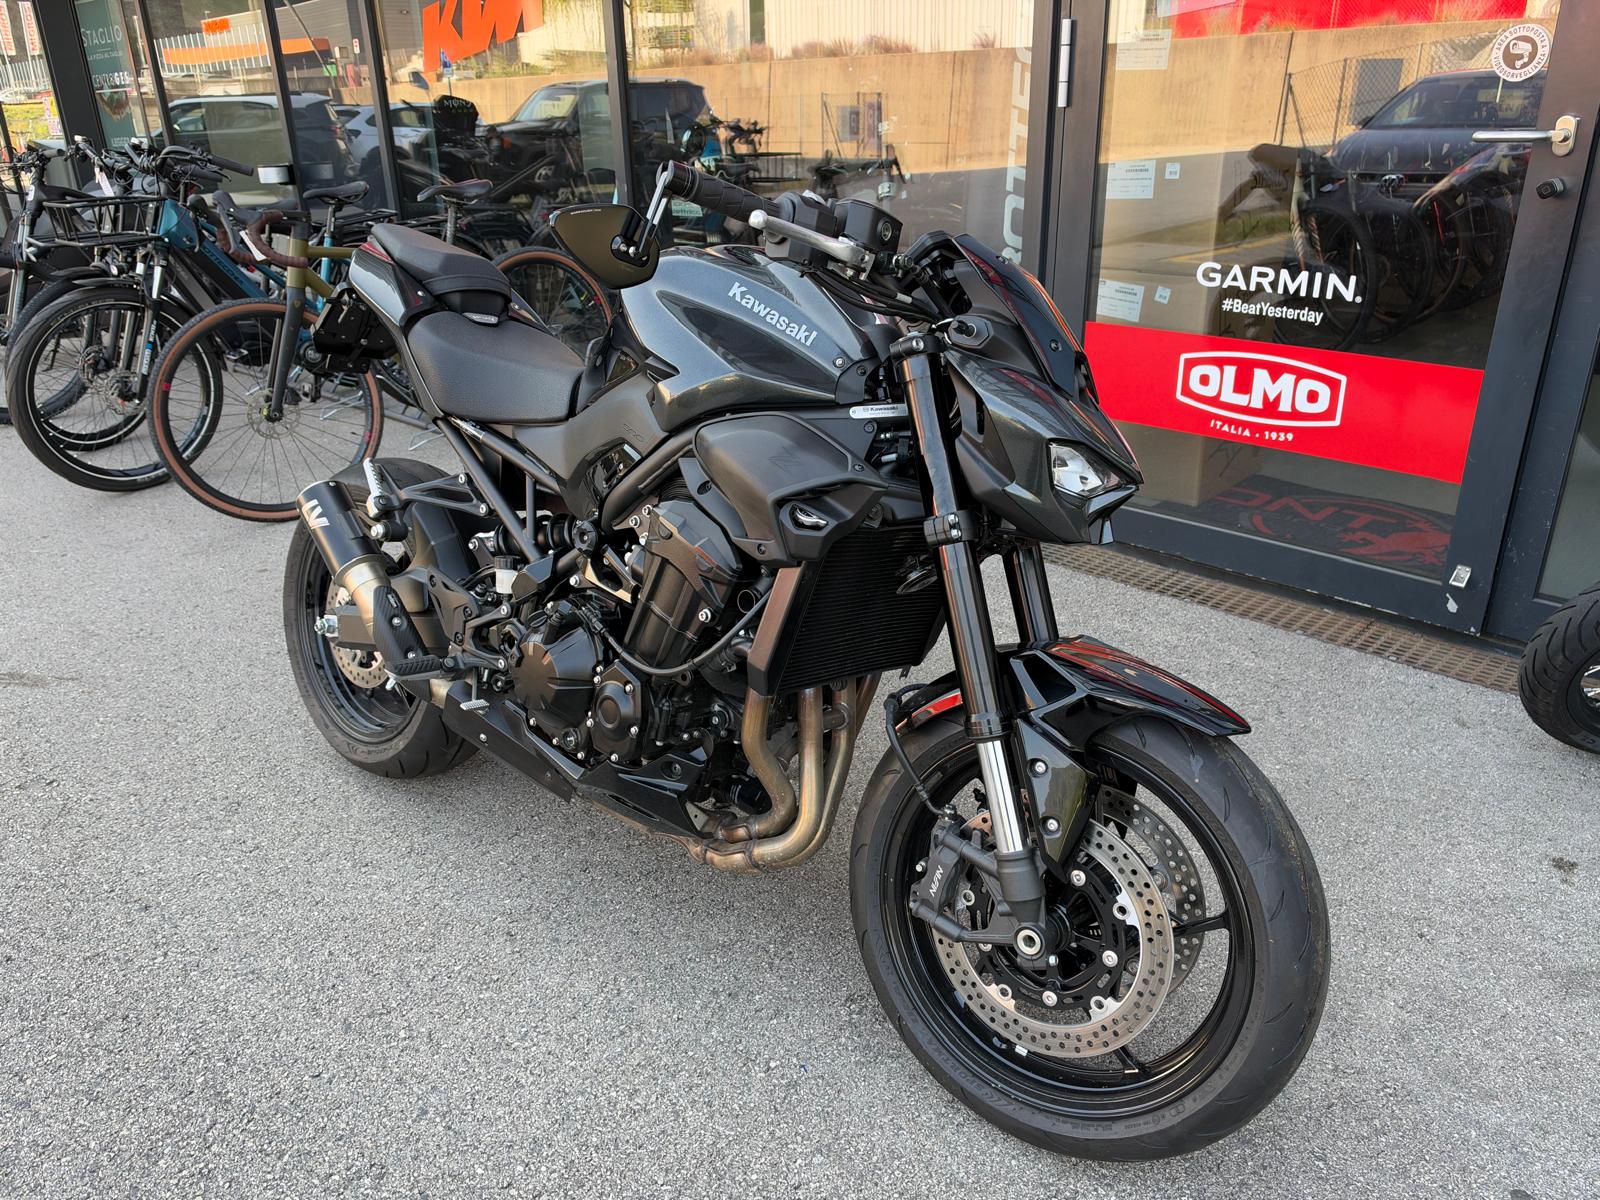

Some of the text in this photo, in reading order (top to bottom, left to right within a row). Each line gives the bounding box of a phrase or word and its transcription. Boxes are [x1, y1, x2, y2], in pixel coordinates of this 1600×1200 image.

[1495, 34, 1509, 51] AREA
[1508, 26, 1546, 44] SOTTOPOSTA
[1493, 53, 1547, 79] VIDEOSORVEGLIANZA
[1196, 261, 1357, 303] GARMIN
[728, 281, 818, 347] Kawasaki
[1222, 297, 1324, 326] #BeatYesterday
[1189, 364, 1331, 414] OLMO
[1210, 419, 1294, 441] ITALIA 1939
